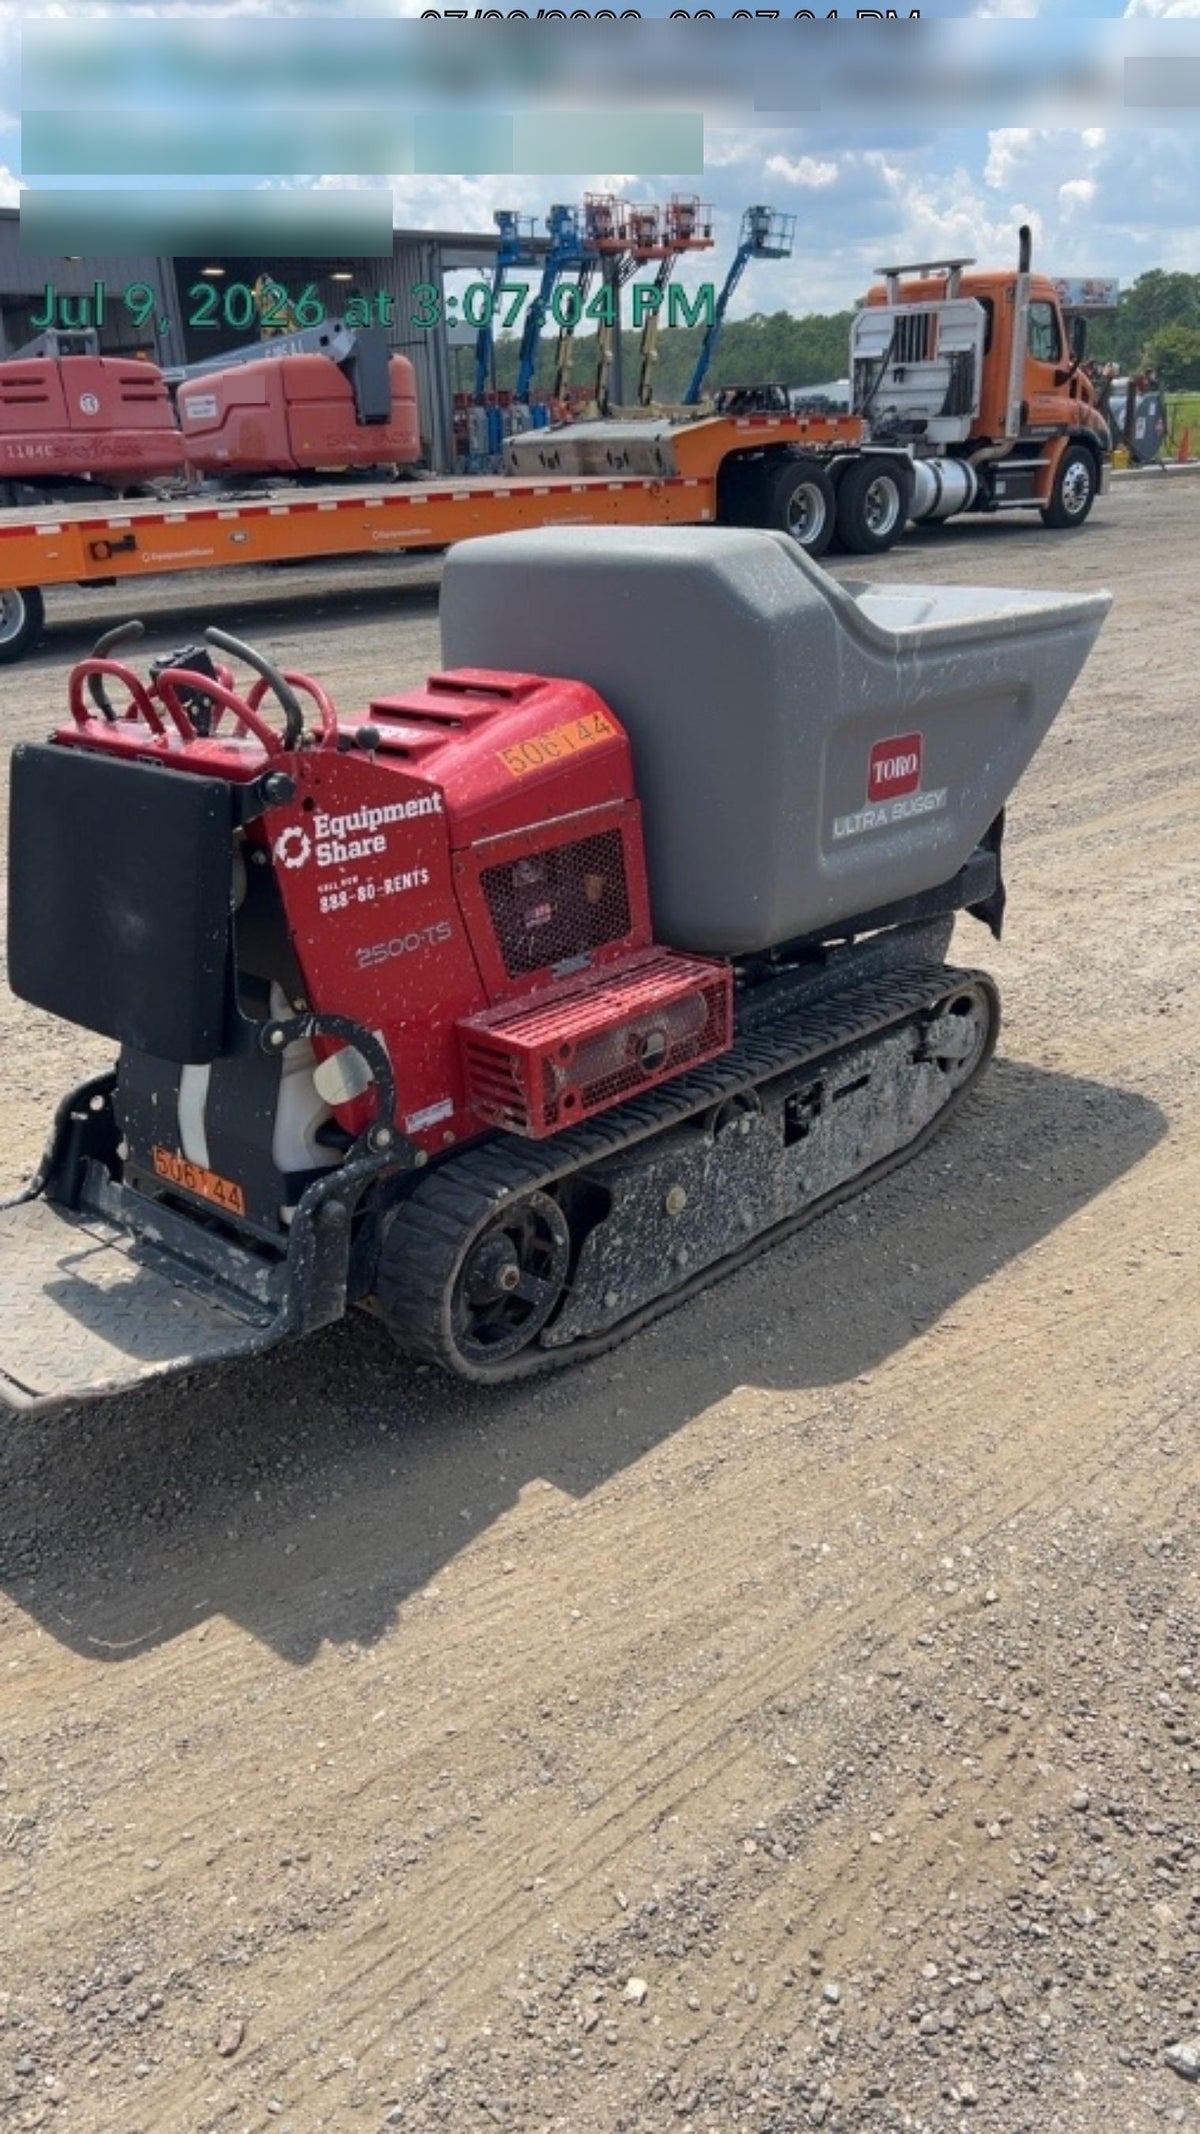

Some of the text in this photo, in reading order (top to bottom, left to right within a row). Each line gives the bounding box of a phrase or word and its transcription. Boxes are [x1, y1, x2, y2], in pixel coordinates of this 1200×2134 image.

[502, 714, 611, 774] 506144
[872, 753, 918, 783] TORO
[312, 790, 443, 839] Equipment
[834, 790, 945, 836] ULTRA BUGGY
[315, 834, 386, 867] Share
[319, 867, 430, 914] 888-80-RENTS
